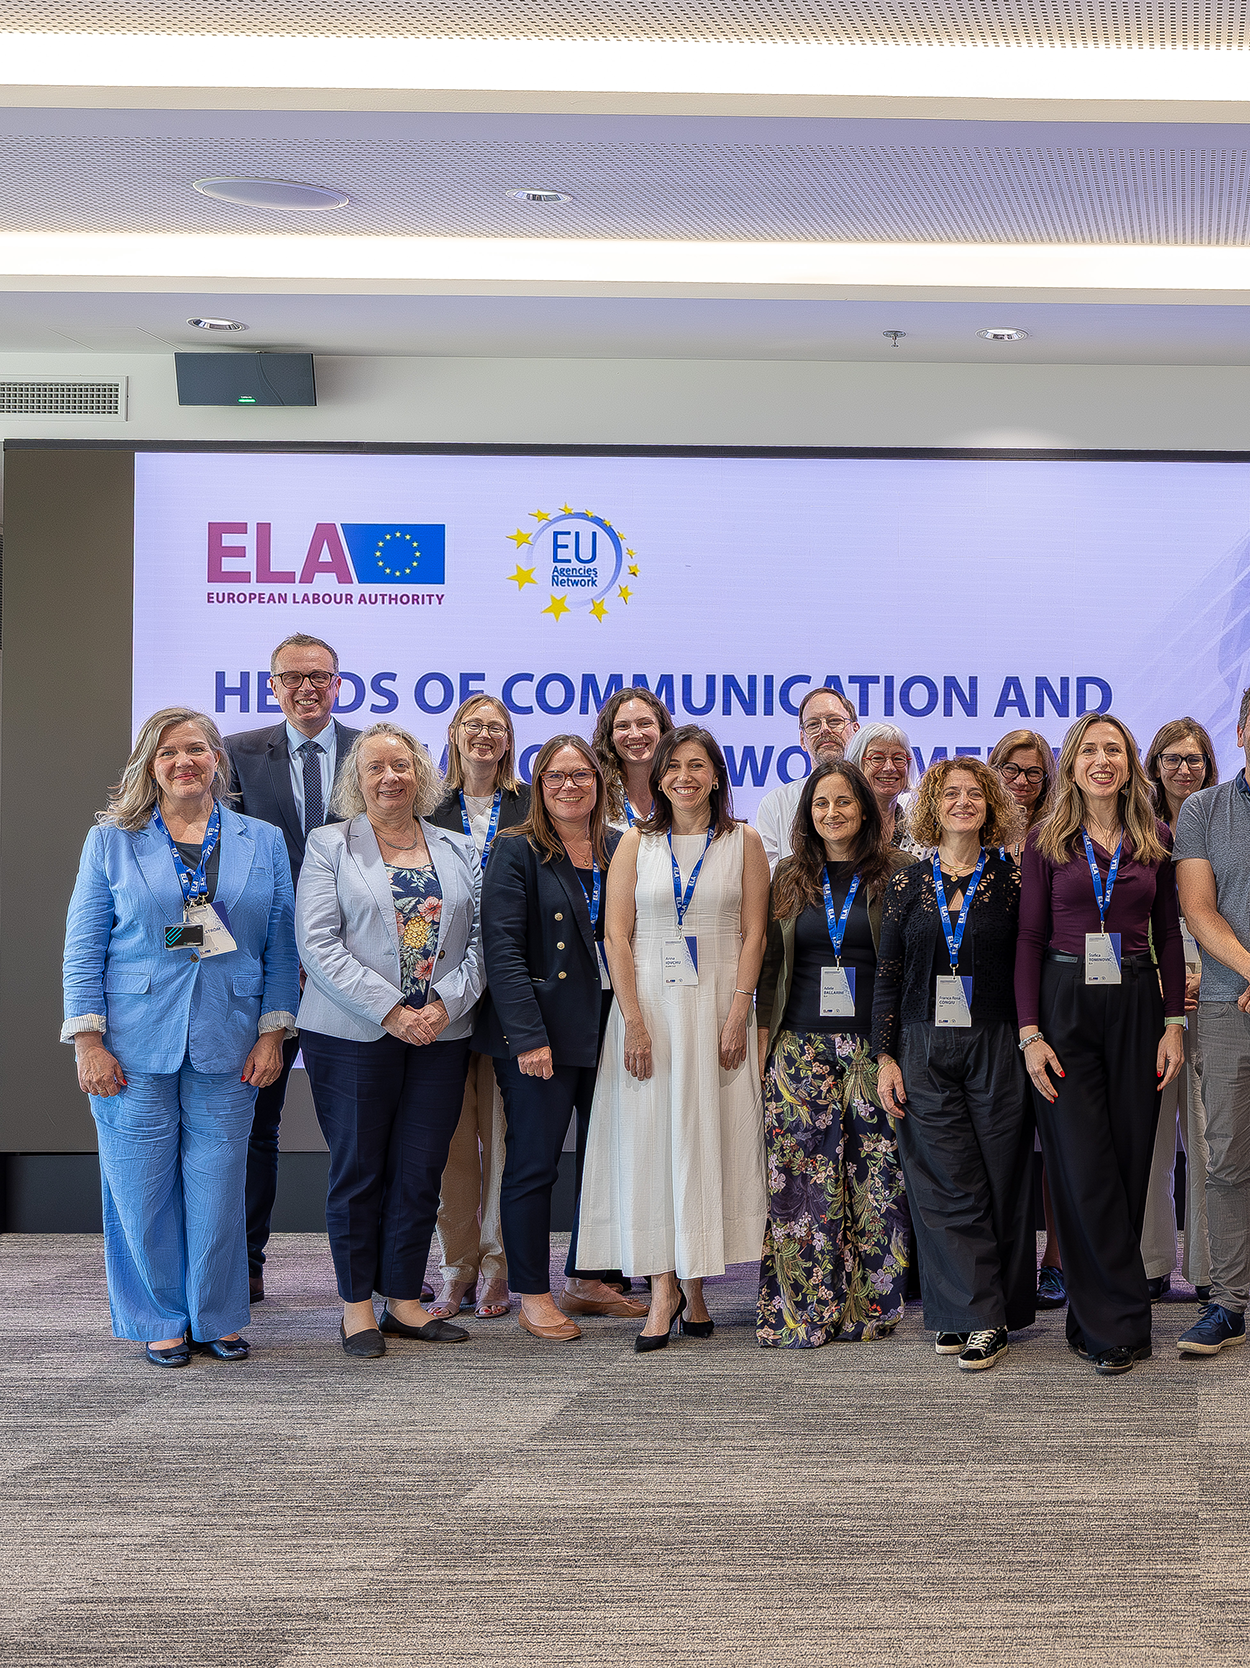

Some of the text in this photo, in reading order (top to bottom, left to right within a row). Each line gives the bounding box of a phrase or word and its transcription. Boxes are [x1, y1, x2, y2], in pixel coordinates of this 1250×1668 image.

[207, 521, 354, 584] ELA
[552, 531, 597, 564] EU
[552, 565, 598, 578] Agencies
[551, 575, 598, 587] Network
[206, 592, 445, 606] EUROPEAN LABOUR AUTHORITY
[215, 671, 399, 714] HEDS
[414, 672, 486, 715] OF
[994, 676, 1113, 718] AND
[170, 847, 180, 858] ELA
[1091, 863, 1099, 875] ELA
[1110, 858, 1118, 870] ELA
[180, 873, 189, 887] ELA
[190, 880, 199, 893] ELA
[850, 883, 858, 893] ELA
[966, 886, 975, 896] ELA
[840, 909, 848, 920] ELA
[941, 906, 949, 916] ELA
[958, 911, 966, 924] ELA
